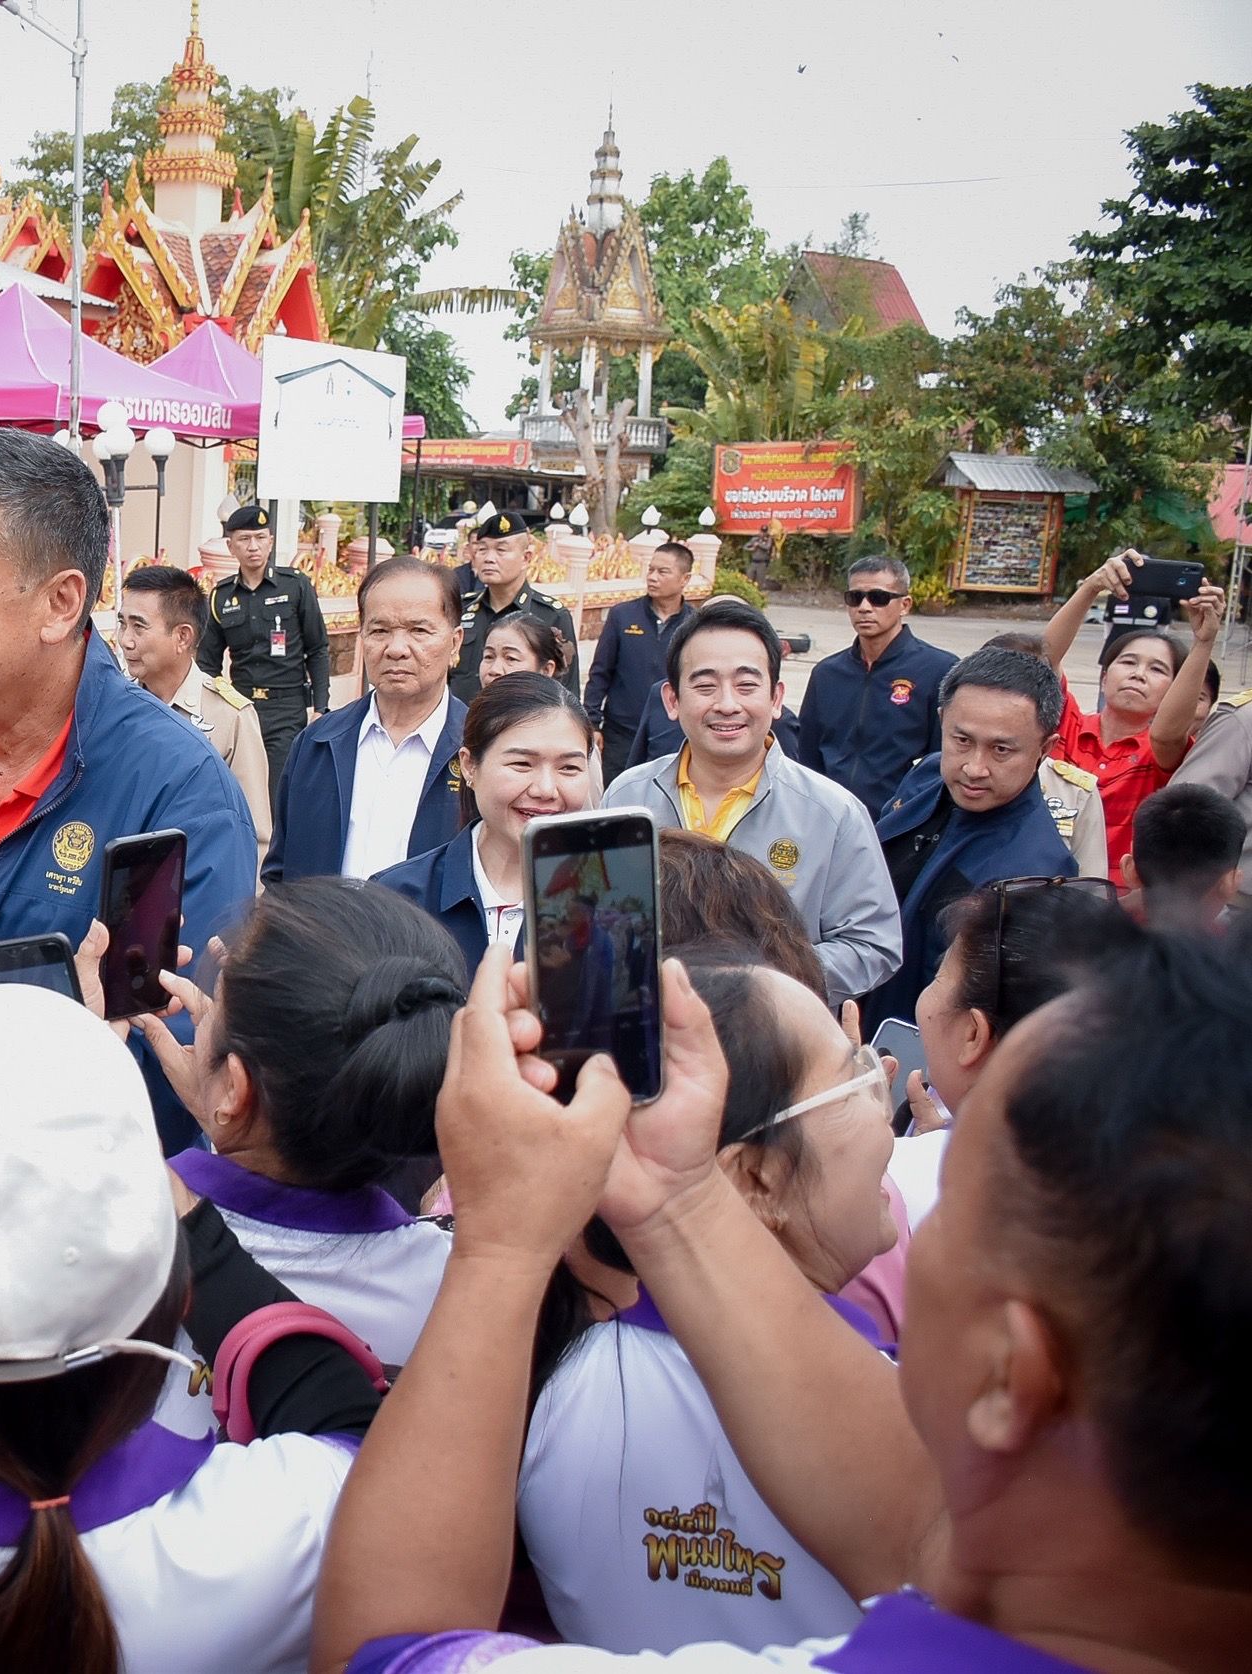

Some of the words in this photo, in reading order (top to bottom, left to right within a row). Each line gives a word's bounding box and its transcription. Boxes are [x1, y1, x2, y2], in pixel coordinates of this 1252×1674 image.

[642, 1528, 786, 1600] พนมไพร
[684, 1569, 753, 1597] เมืองคนดี
